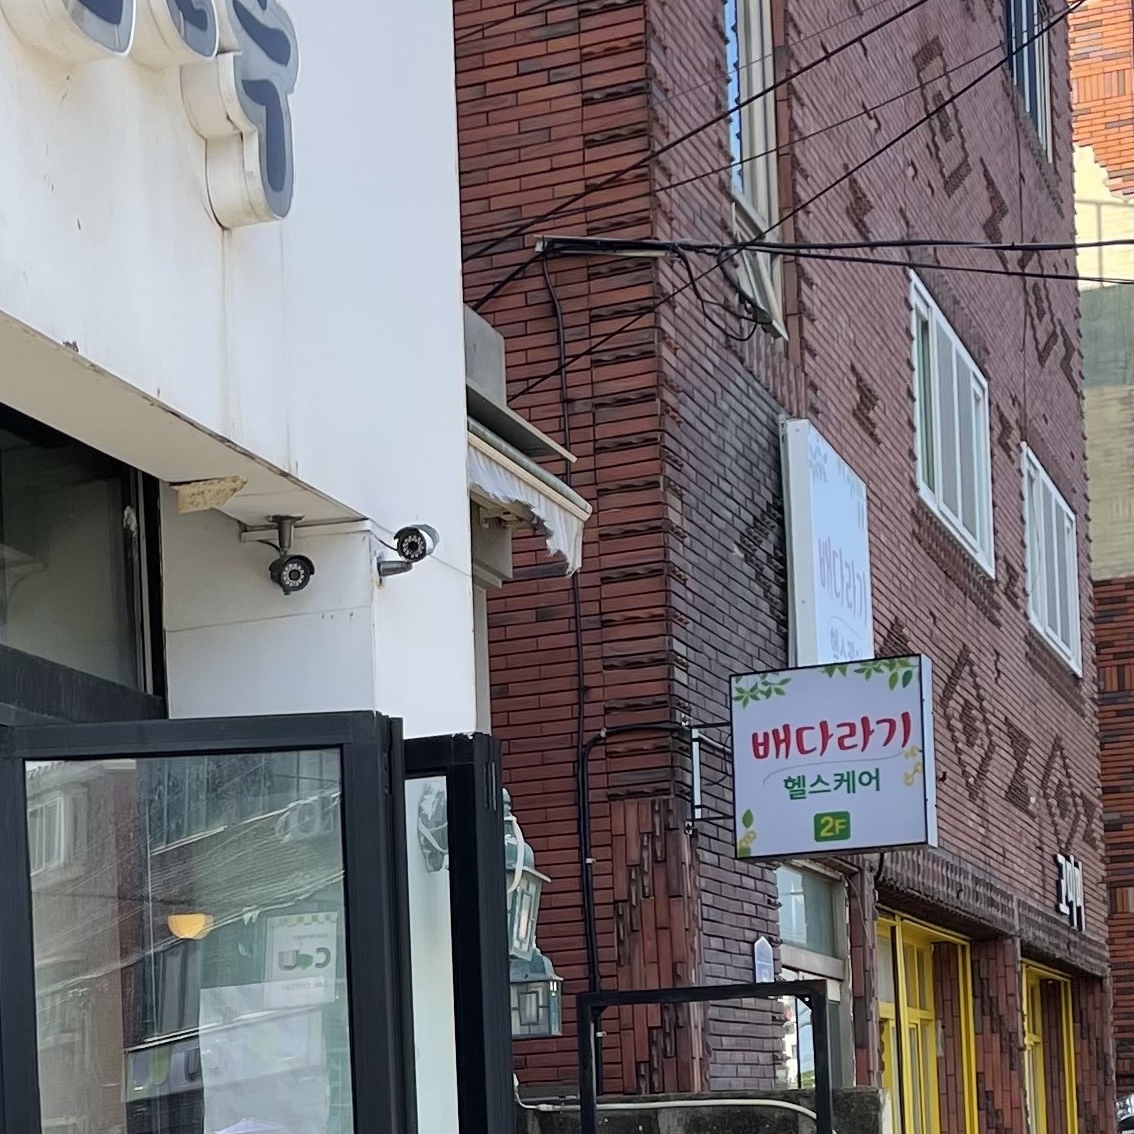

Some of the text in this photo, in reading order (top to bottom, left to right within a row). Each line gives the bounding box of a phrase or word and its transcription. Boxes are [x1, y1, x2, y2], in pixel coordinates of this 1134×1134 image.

[752, 711, 911, 759] 배다라기
[783, 767, 882, 801] 헬스케어
[820, 816, 847, 837] 2F
